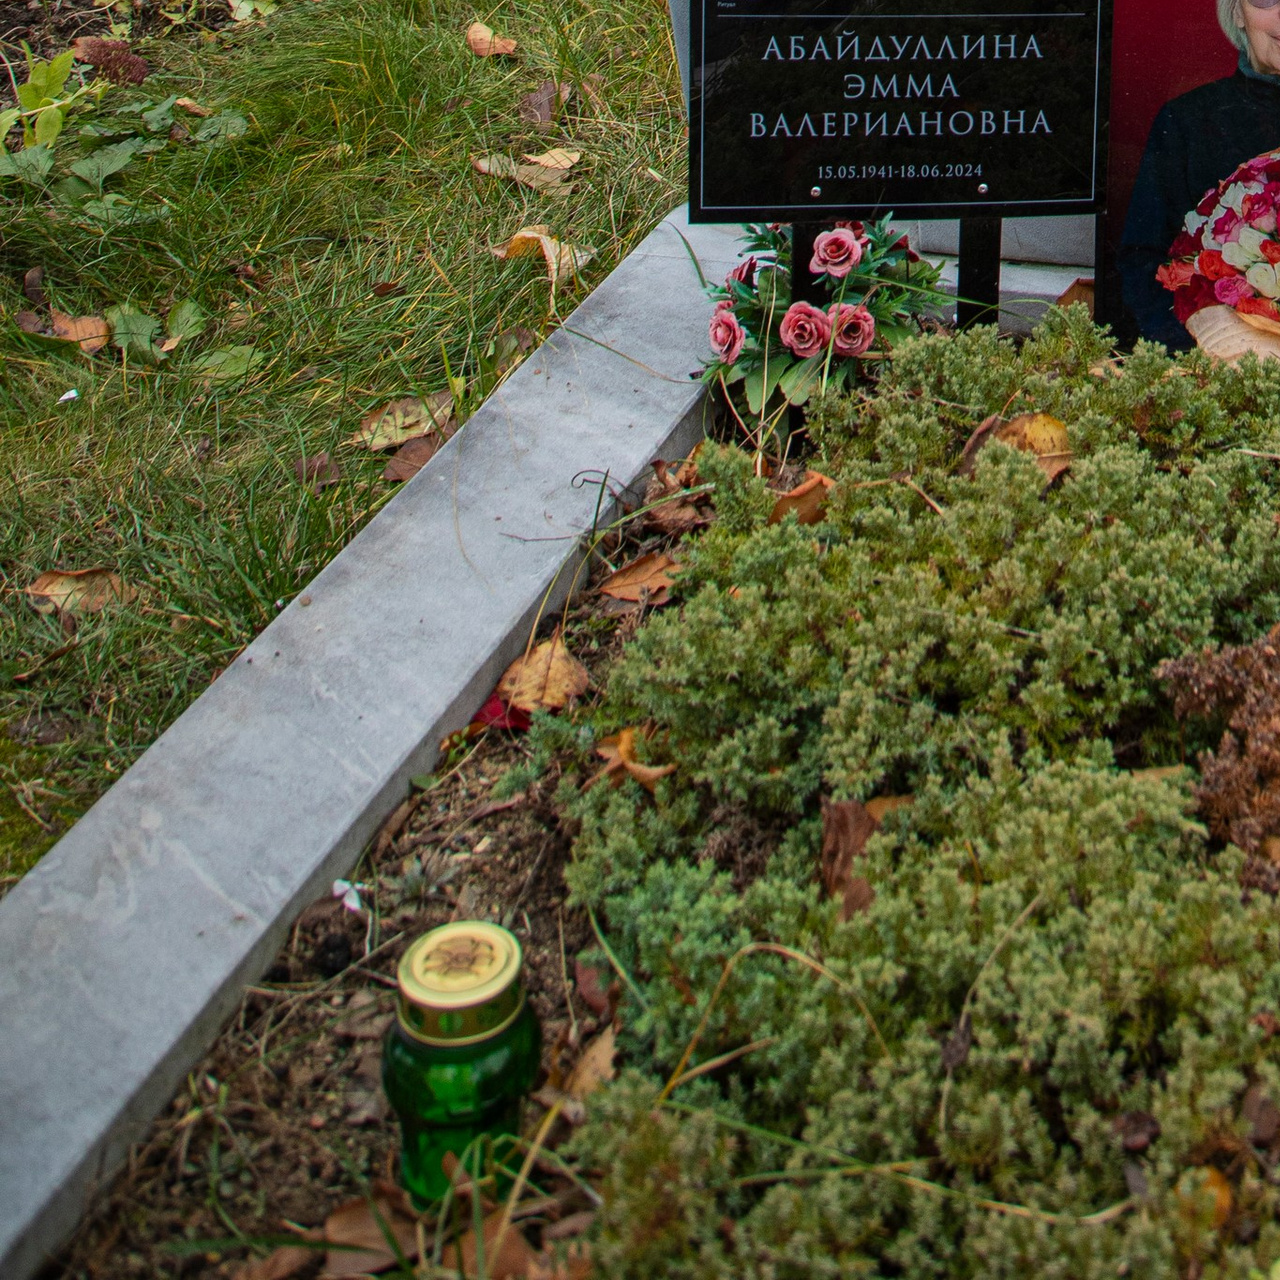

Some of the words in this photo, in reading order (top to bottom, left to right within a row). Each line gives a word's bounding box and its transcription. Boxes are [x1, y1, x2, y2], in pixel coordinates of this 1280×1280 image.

[761, 29, 1044, 61] АБАЙДУЛЛИНА
[843, 73, 960, 99] ЭММА
[750, 109, 1052, 138] ВАЛЕРИАНОВНА
[818, 163, 983, 180] 15.05.1941-18.06.2024
